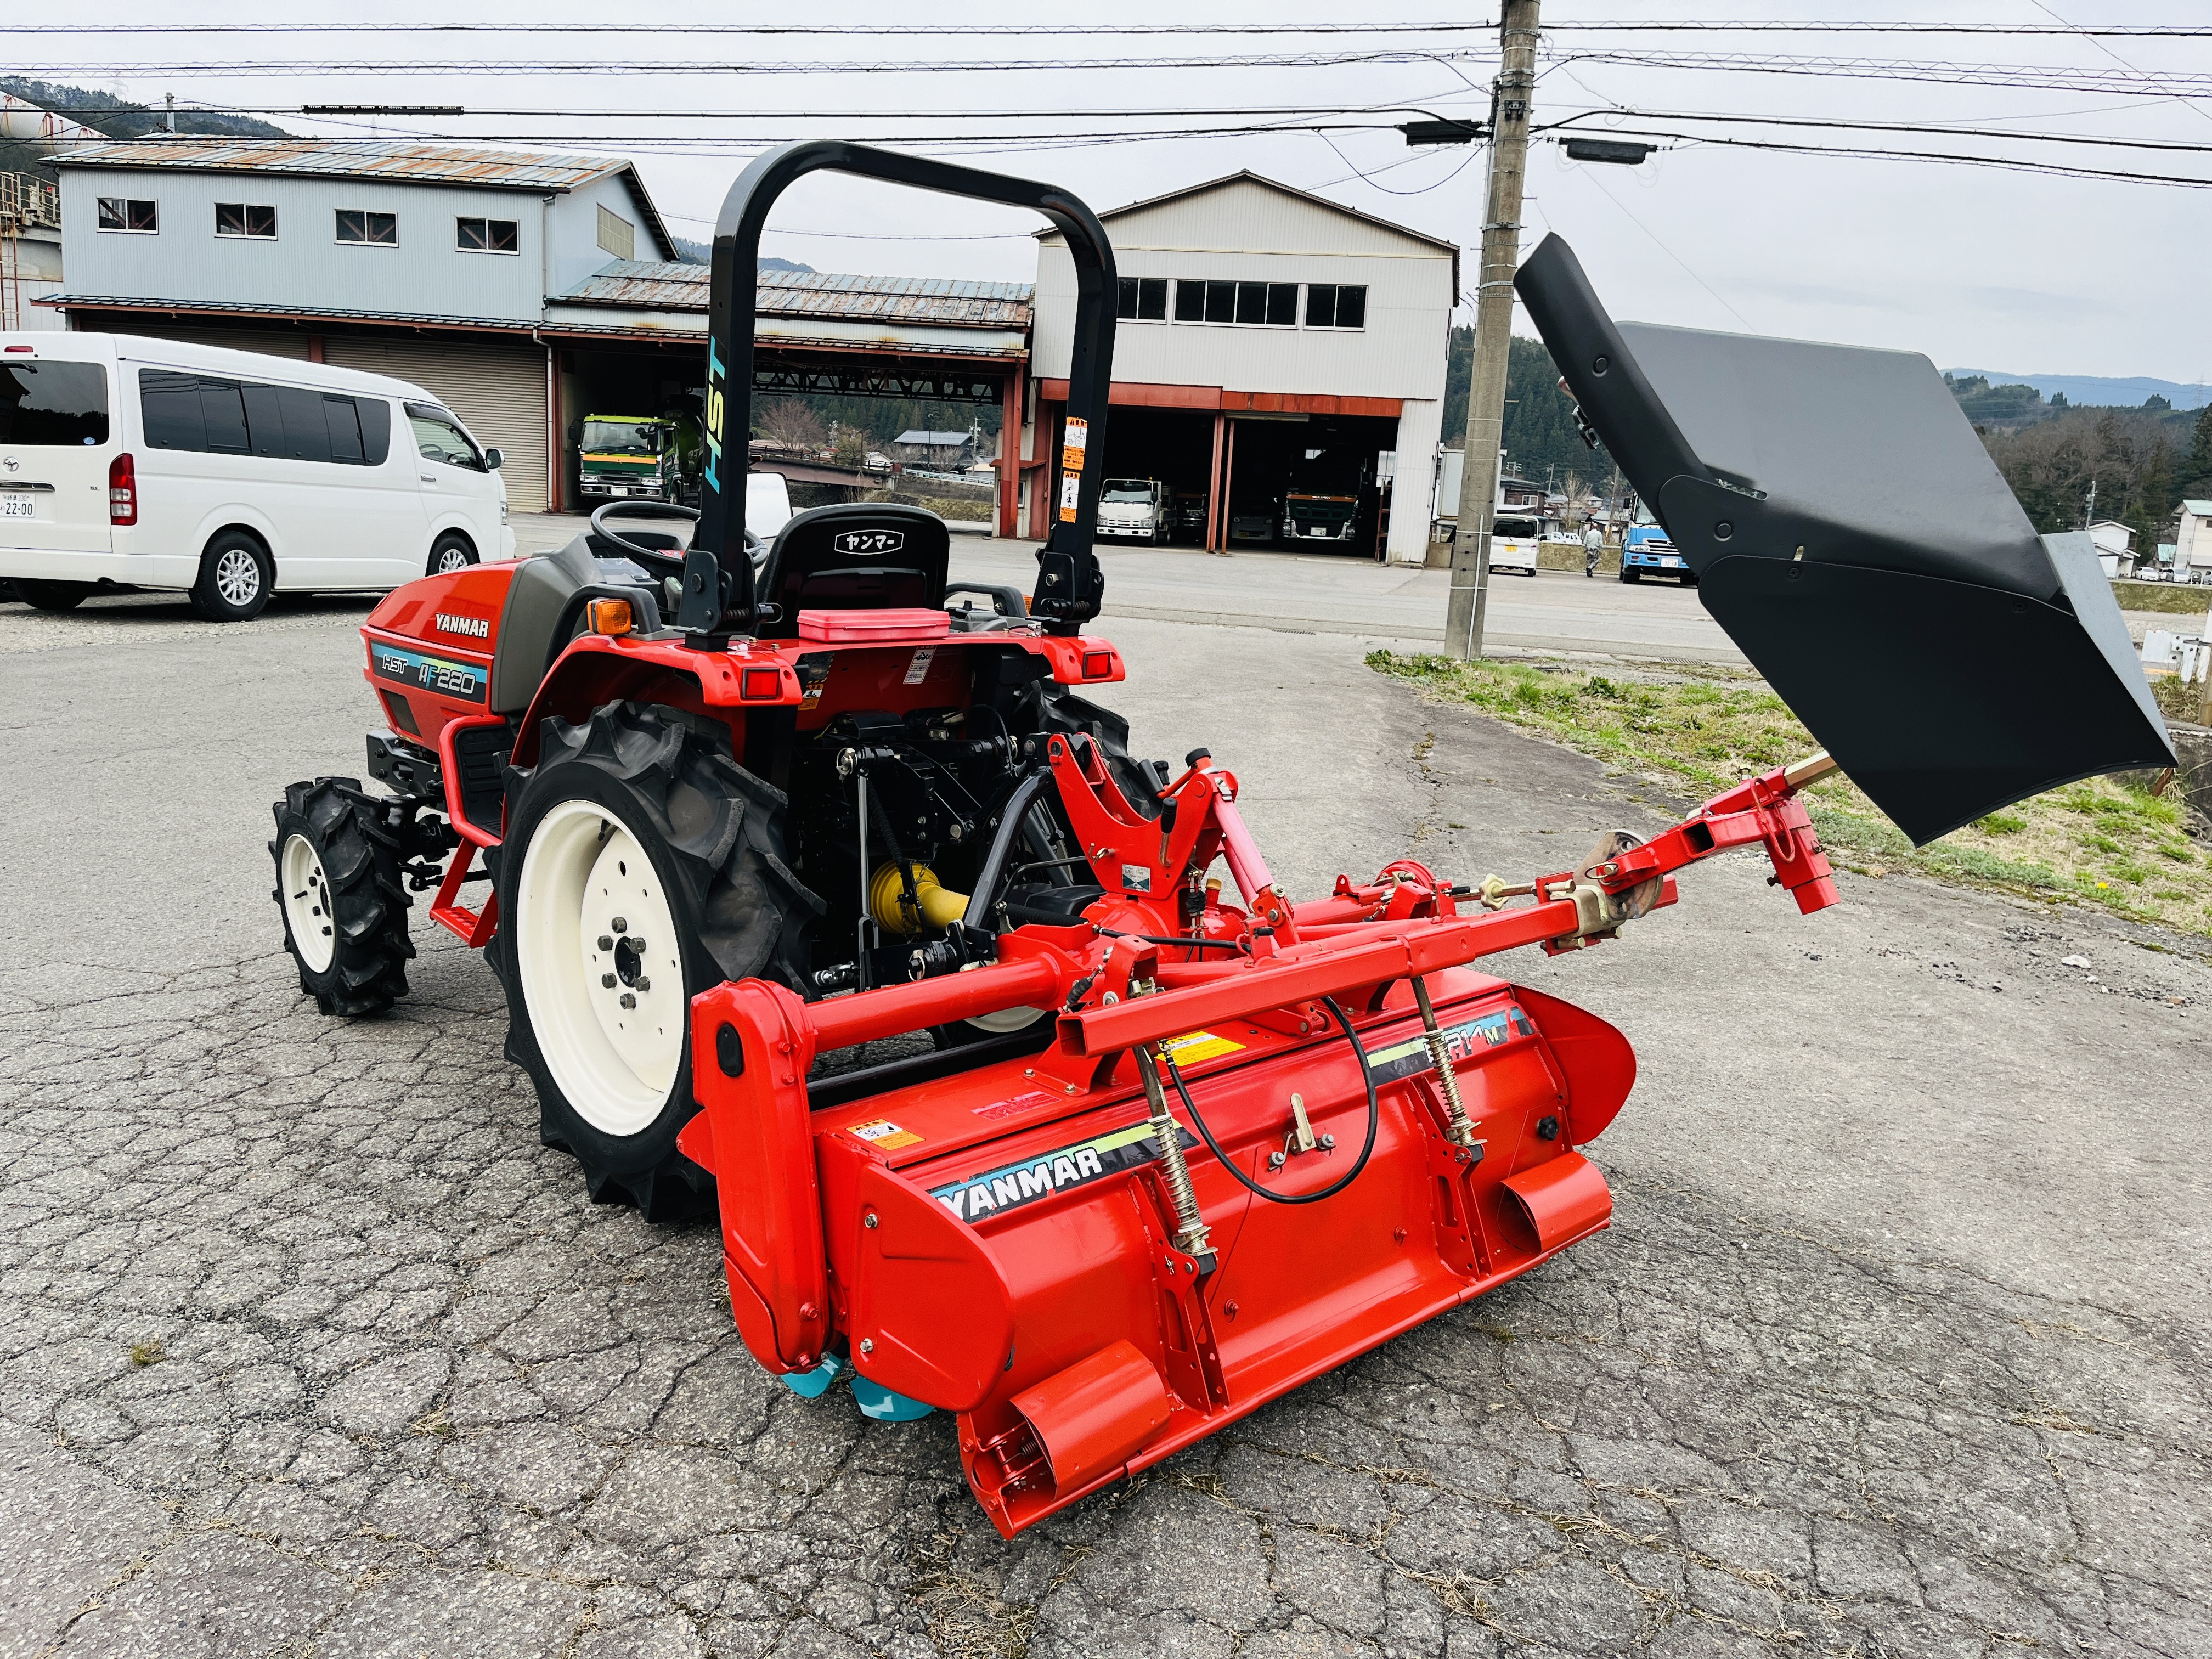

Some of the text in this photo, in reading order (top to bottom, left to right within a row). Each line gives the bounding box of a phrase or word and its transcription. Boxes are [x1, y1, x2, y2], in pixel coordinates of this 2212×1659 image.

[705, 335, 725, 494] HST
[6, 503, 32, 515] 22-00
[847, 535, 895, 550] ヤンマー
[436, 613, 489, 638] YANMAR
[382, 654, 476, 695] HST AF220
[936, 1147, 1103, 1221] YANMAR
